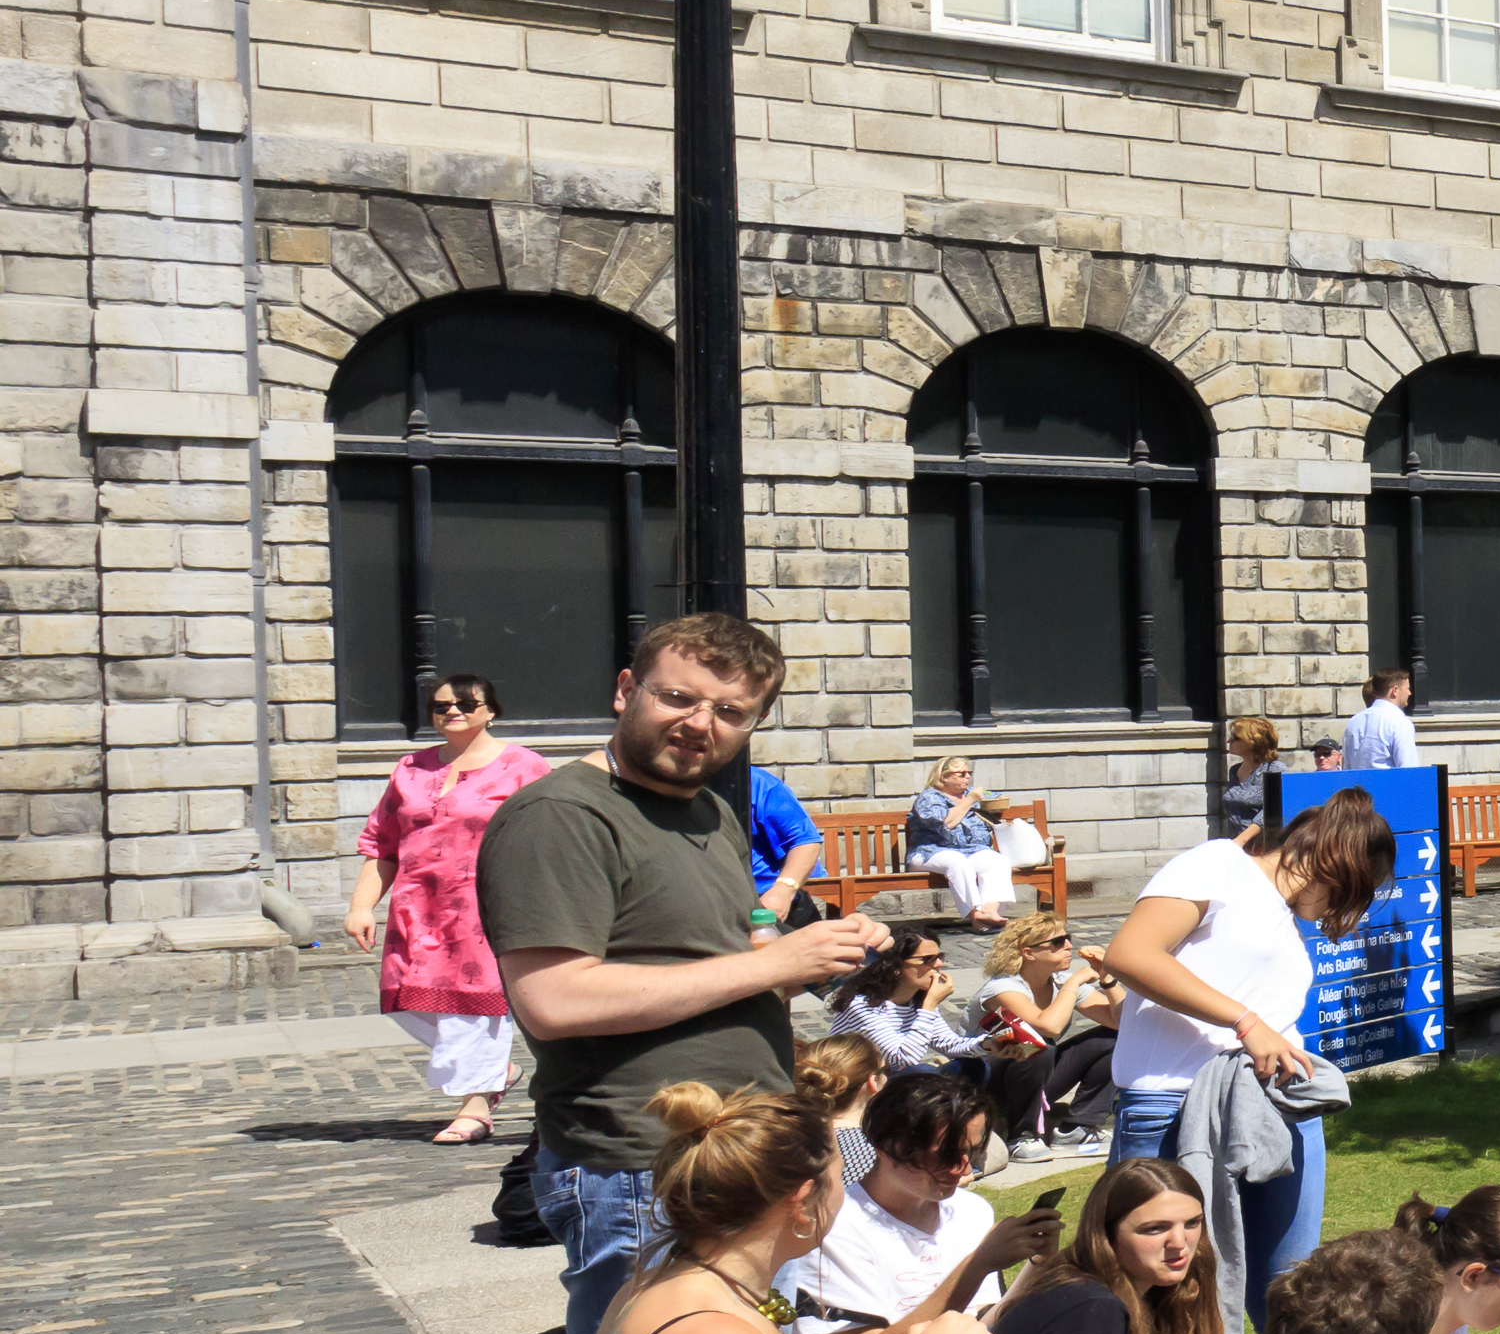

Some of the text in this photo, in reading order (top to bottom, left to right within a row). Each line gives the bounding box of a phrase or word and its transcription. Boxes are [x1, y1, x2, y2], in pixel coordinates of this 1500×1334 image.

[1367, 936, 1377, 947] na
[1317, 956, 1368, 976] Arts Building
[1318, 987, 1343, 1004] Áiléar
[1378, 980, 1389, 991] de
[1319, 997, 1405, 1024] Douglas Hyde Gallery
[1318, 1036, 1344, 1052] Geata
[1346, 1035, 1356, 1046] na
[1331, 1048, 1384, 1068] destrian Gate
